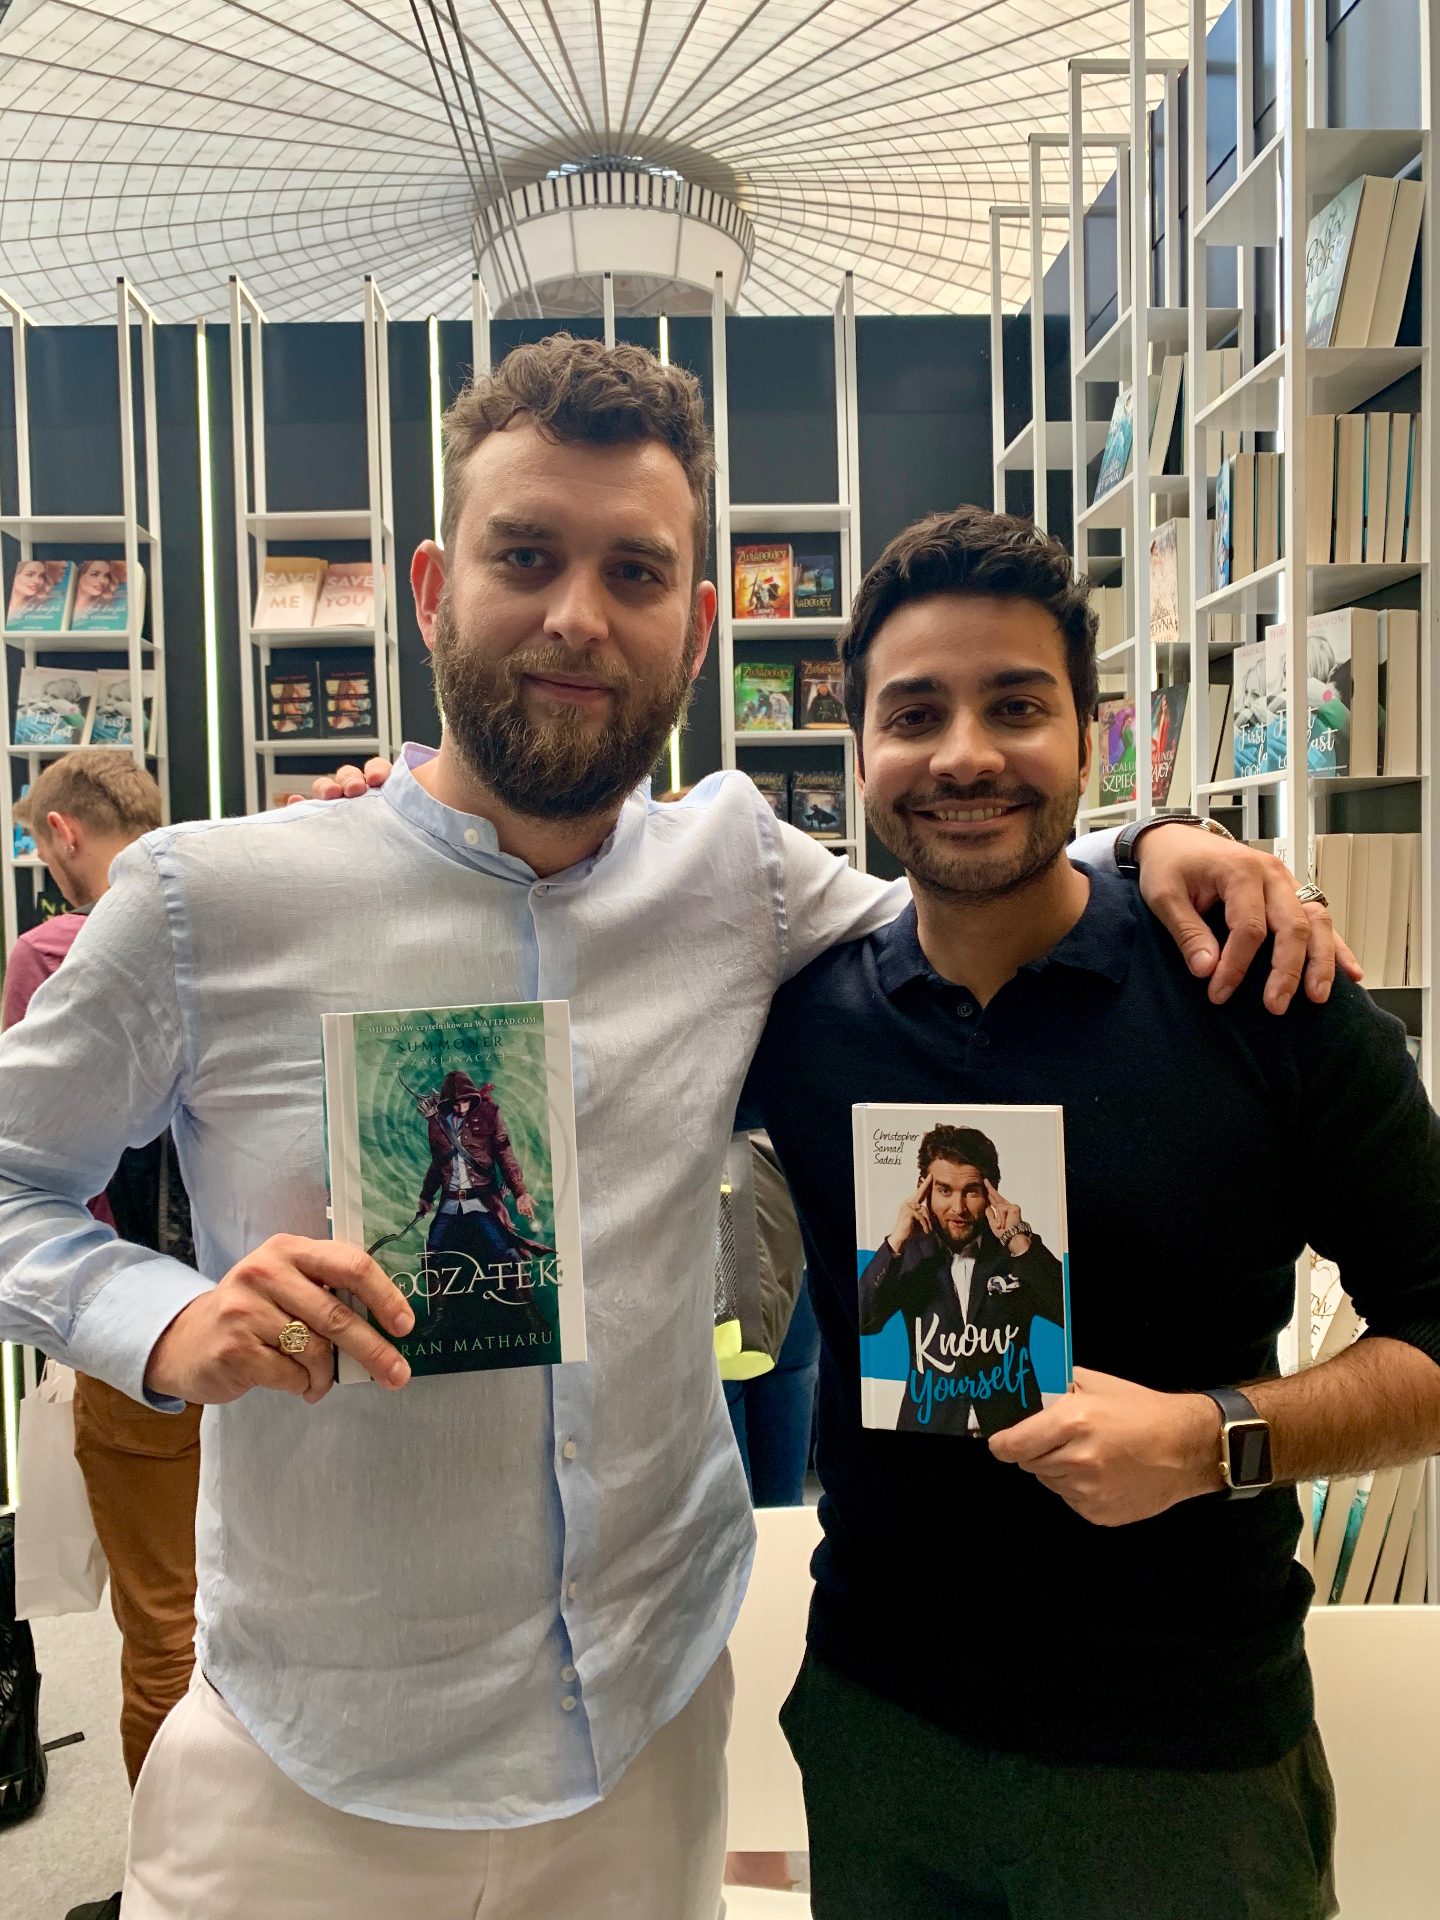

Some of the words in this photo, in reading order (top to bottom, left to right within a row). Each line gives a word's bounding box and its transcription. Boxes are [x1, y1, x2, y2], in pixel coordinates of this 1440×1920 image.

[263, 573, 315, 586] SAVE
[326, 576, 374, 588] SAVE
[270, 596, 301, 608] ME
[326, 595, 367, 608] YOU
[795, 598, 832, 608] IADOWCY
[1309, 615, 1347, 630] OSIVONI
[1238, 723, 1267, 751] First
[368, 1024, 413, 1034] MILIONÓW
[475, 1016, 537, 1027] WATTPAD.COM
[396, 1036, 503, 1054] SUMMONER
[410, 1054, 493, 1067] ZAKLINACZ
[873, 1128, 919, 1141] Christopher
[453, 1331, 553, 1353] MATHARU
[915, 1313, 1019, 1375] Know
[909, 1340, 1030, 1425] Yourself
